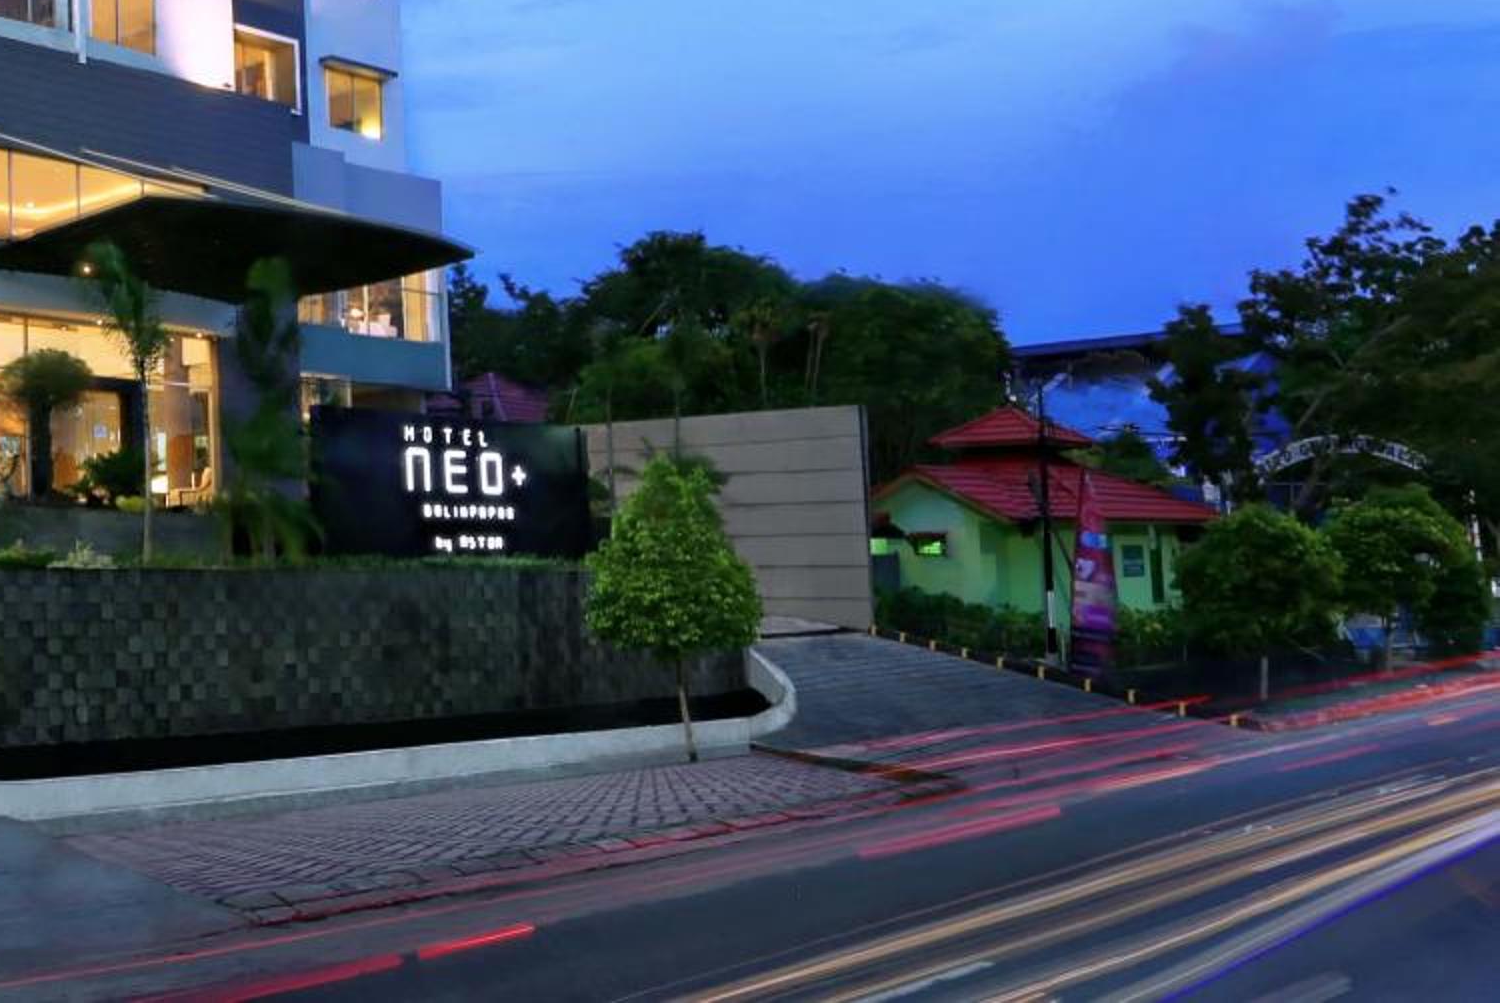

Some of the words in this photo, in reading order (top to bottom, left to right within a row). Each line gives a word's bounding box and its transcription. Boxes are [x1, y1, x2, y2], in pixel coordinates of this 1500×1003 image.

[404, 426, 488, 447] HOTEL
[435, 536, 452, 552] by
[459, 535, 504, 550] ASTON
